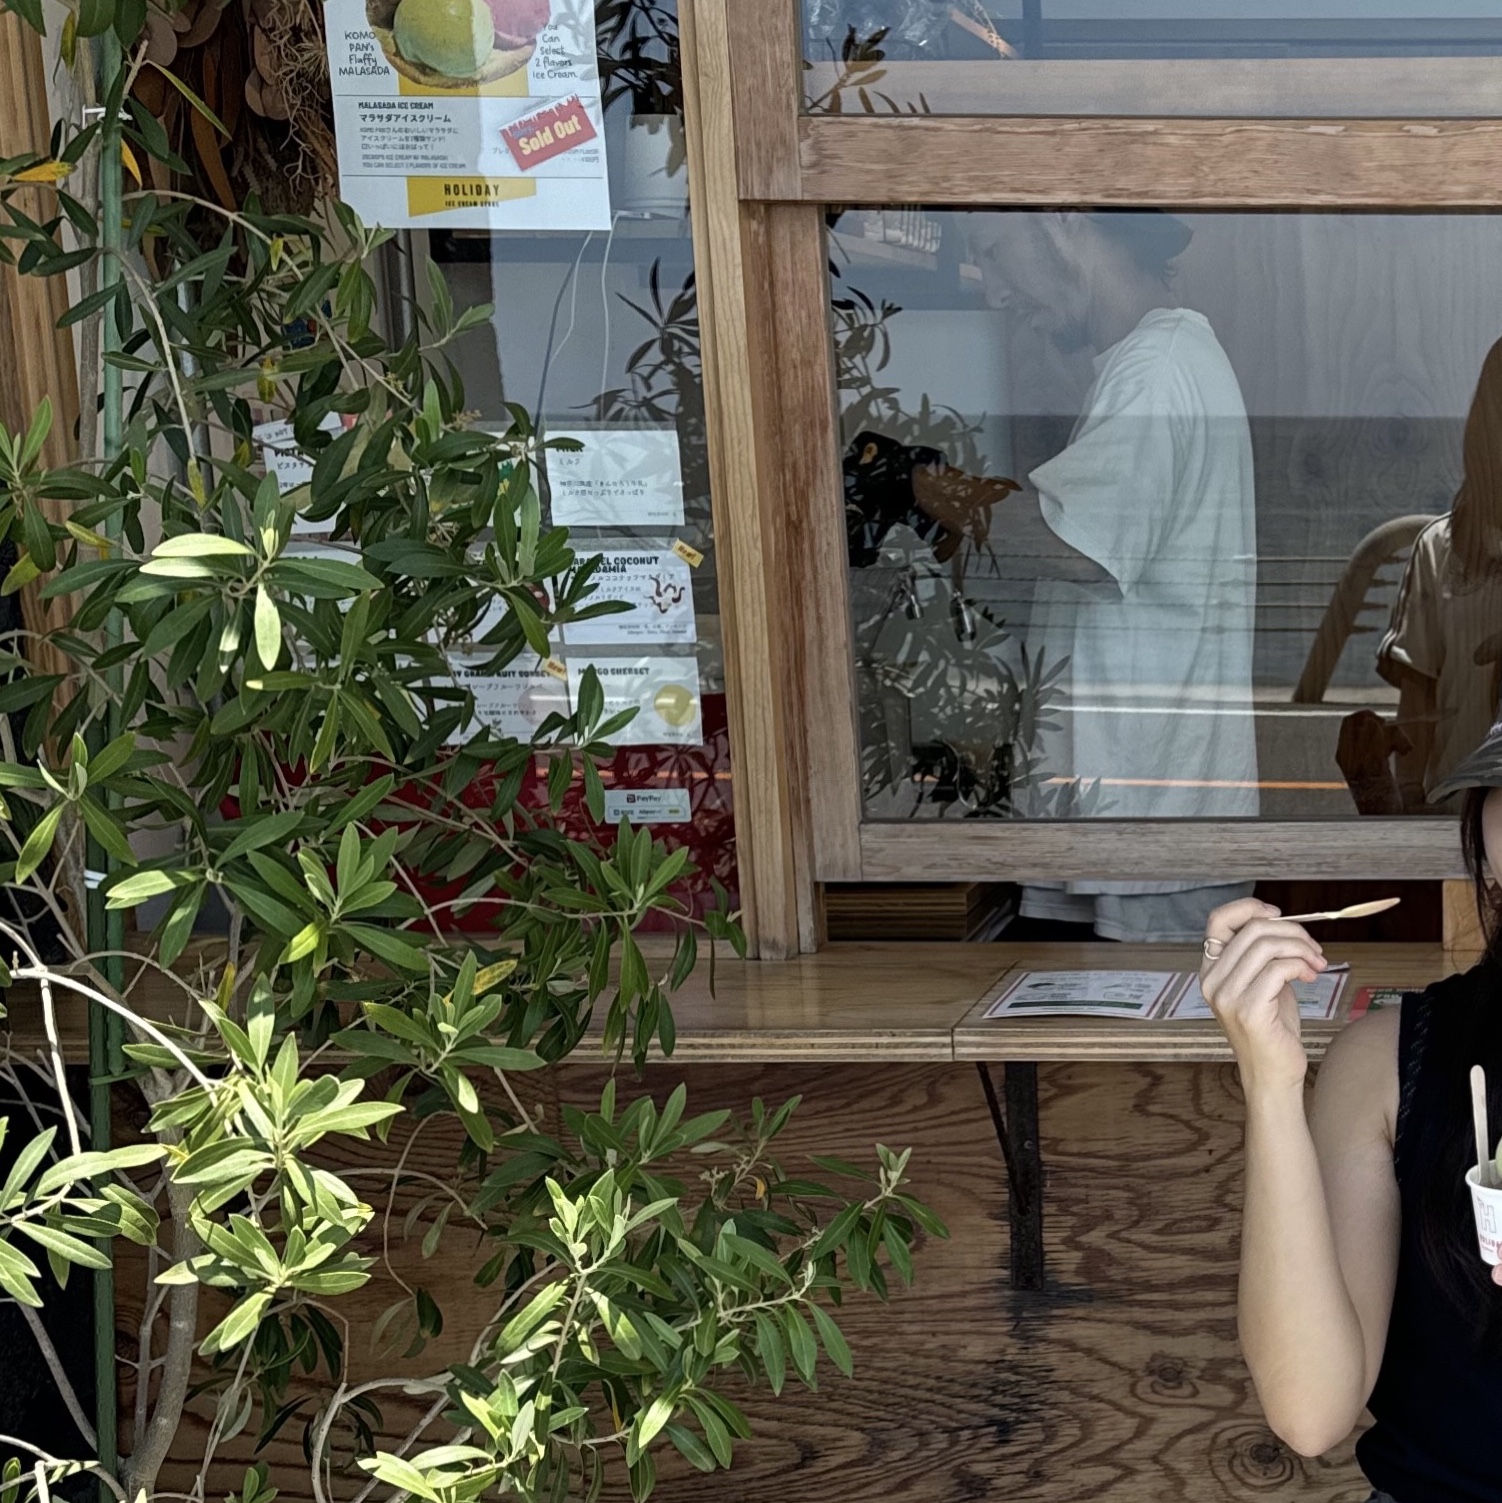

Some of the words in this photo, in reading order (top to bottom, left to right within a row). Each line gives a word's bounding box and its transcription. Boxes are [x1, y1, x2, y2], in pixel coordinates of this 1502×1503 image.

[344, 31, 377, 40] KOMO
[541, 34, 560, 43] Can
[338, 65, 390, 77] MALASADA
[360, 114, 452, 122] マラサダアイスクリーム
[519, 126, 554, 155] Sold
[553, 115, 581, 138] Out
[444, 183, 500, 196] HOLIDAY
[614, 557, 659, 566] COCONUT
